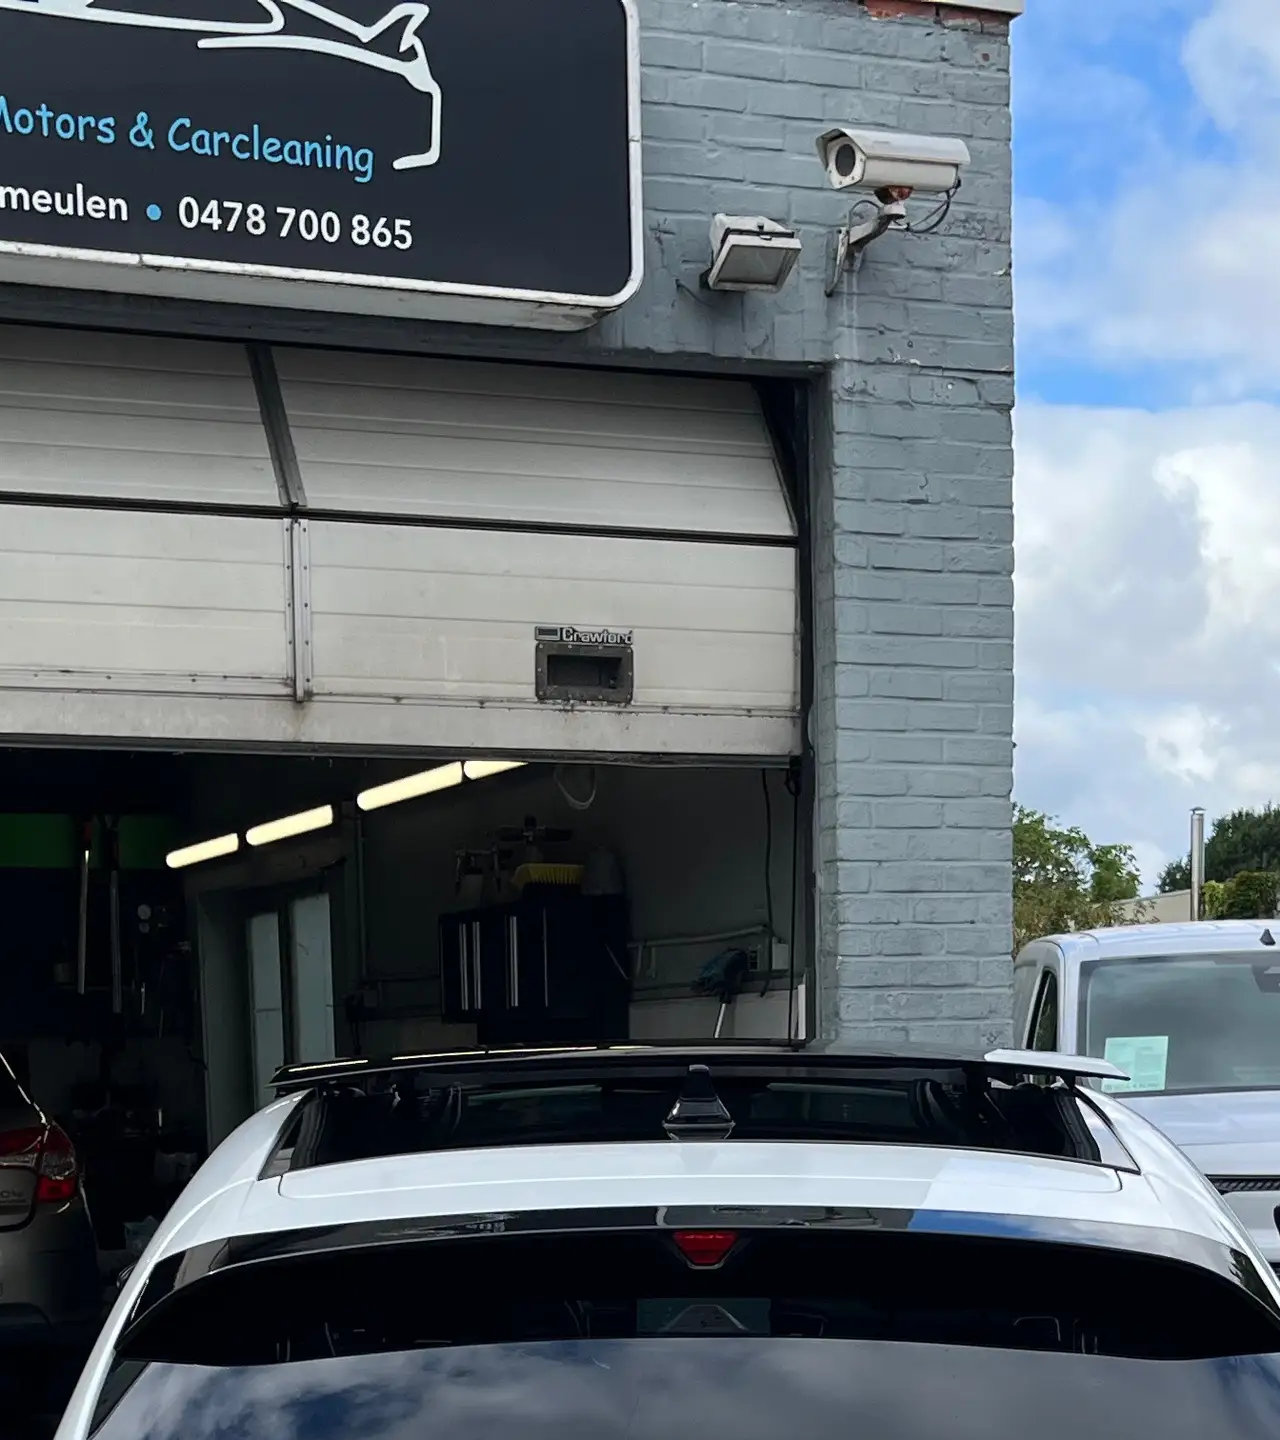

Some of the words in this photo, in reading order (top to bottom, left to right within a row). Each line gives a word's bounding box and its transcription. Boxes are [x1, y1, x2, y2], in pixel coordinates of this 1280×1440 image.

[128, 110, 155, 150] &
[167, 116, 374, 183] Carcleaning
[178, 196, 267, 236] 0478
[276, 206, 341, 243] 700
[351, 214, 413, 250] 865
[562, 627, 632, 644] Crawford
